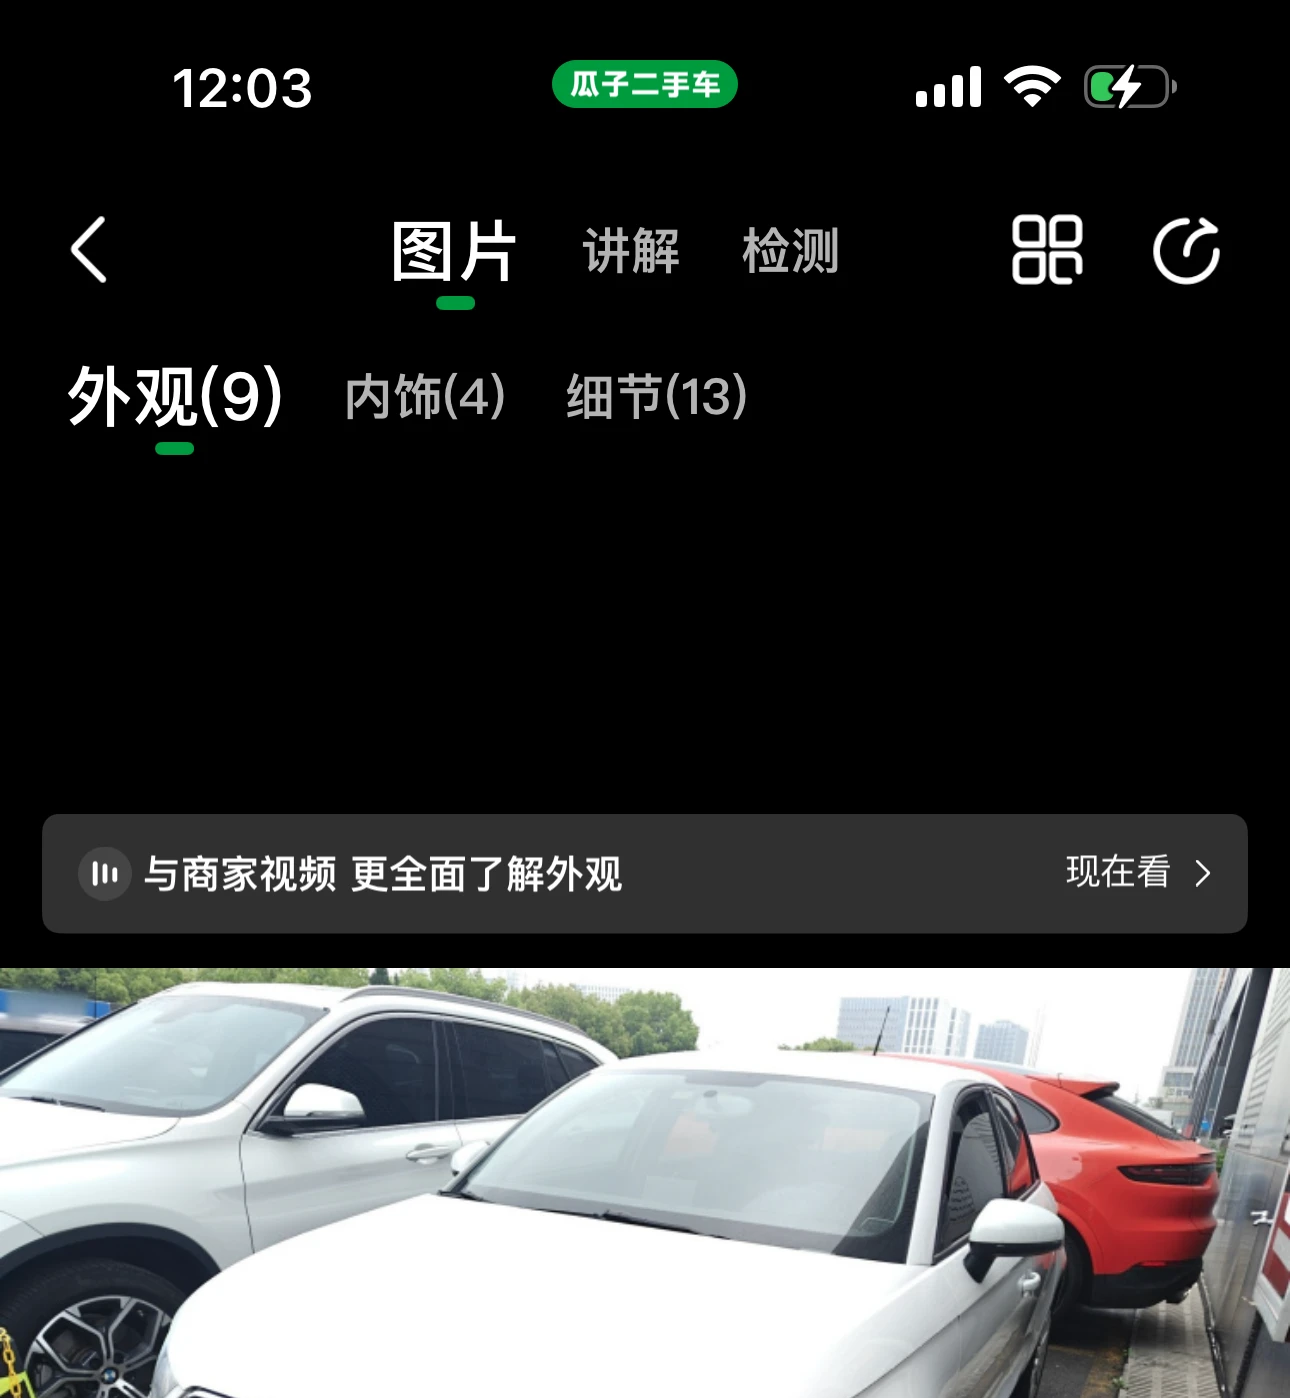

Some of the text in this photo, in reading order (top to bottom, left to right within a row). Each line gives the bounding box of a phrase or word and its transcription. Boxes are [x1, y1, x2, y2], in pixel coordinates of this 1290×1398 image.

[174, 68, 311, 108] 12:03
[570, 70, 722, 99] 瓜子二手车
[393, 219, 516, 282] 图片
[583, 226, 680, 274] 讲解
[742, 226, 838, 274] 检测
[67, 365, 282, 428] 外观(9)
[347, 372, 505, 421] 内饰(4)
[566, 372, 747, 421] 细节(13)
[144, 854, 623, 893] 与商家视频 更全面了解外观
[1066, 853, 1171, 889] 现在看
